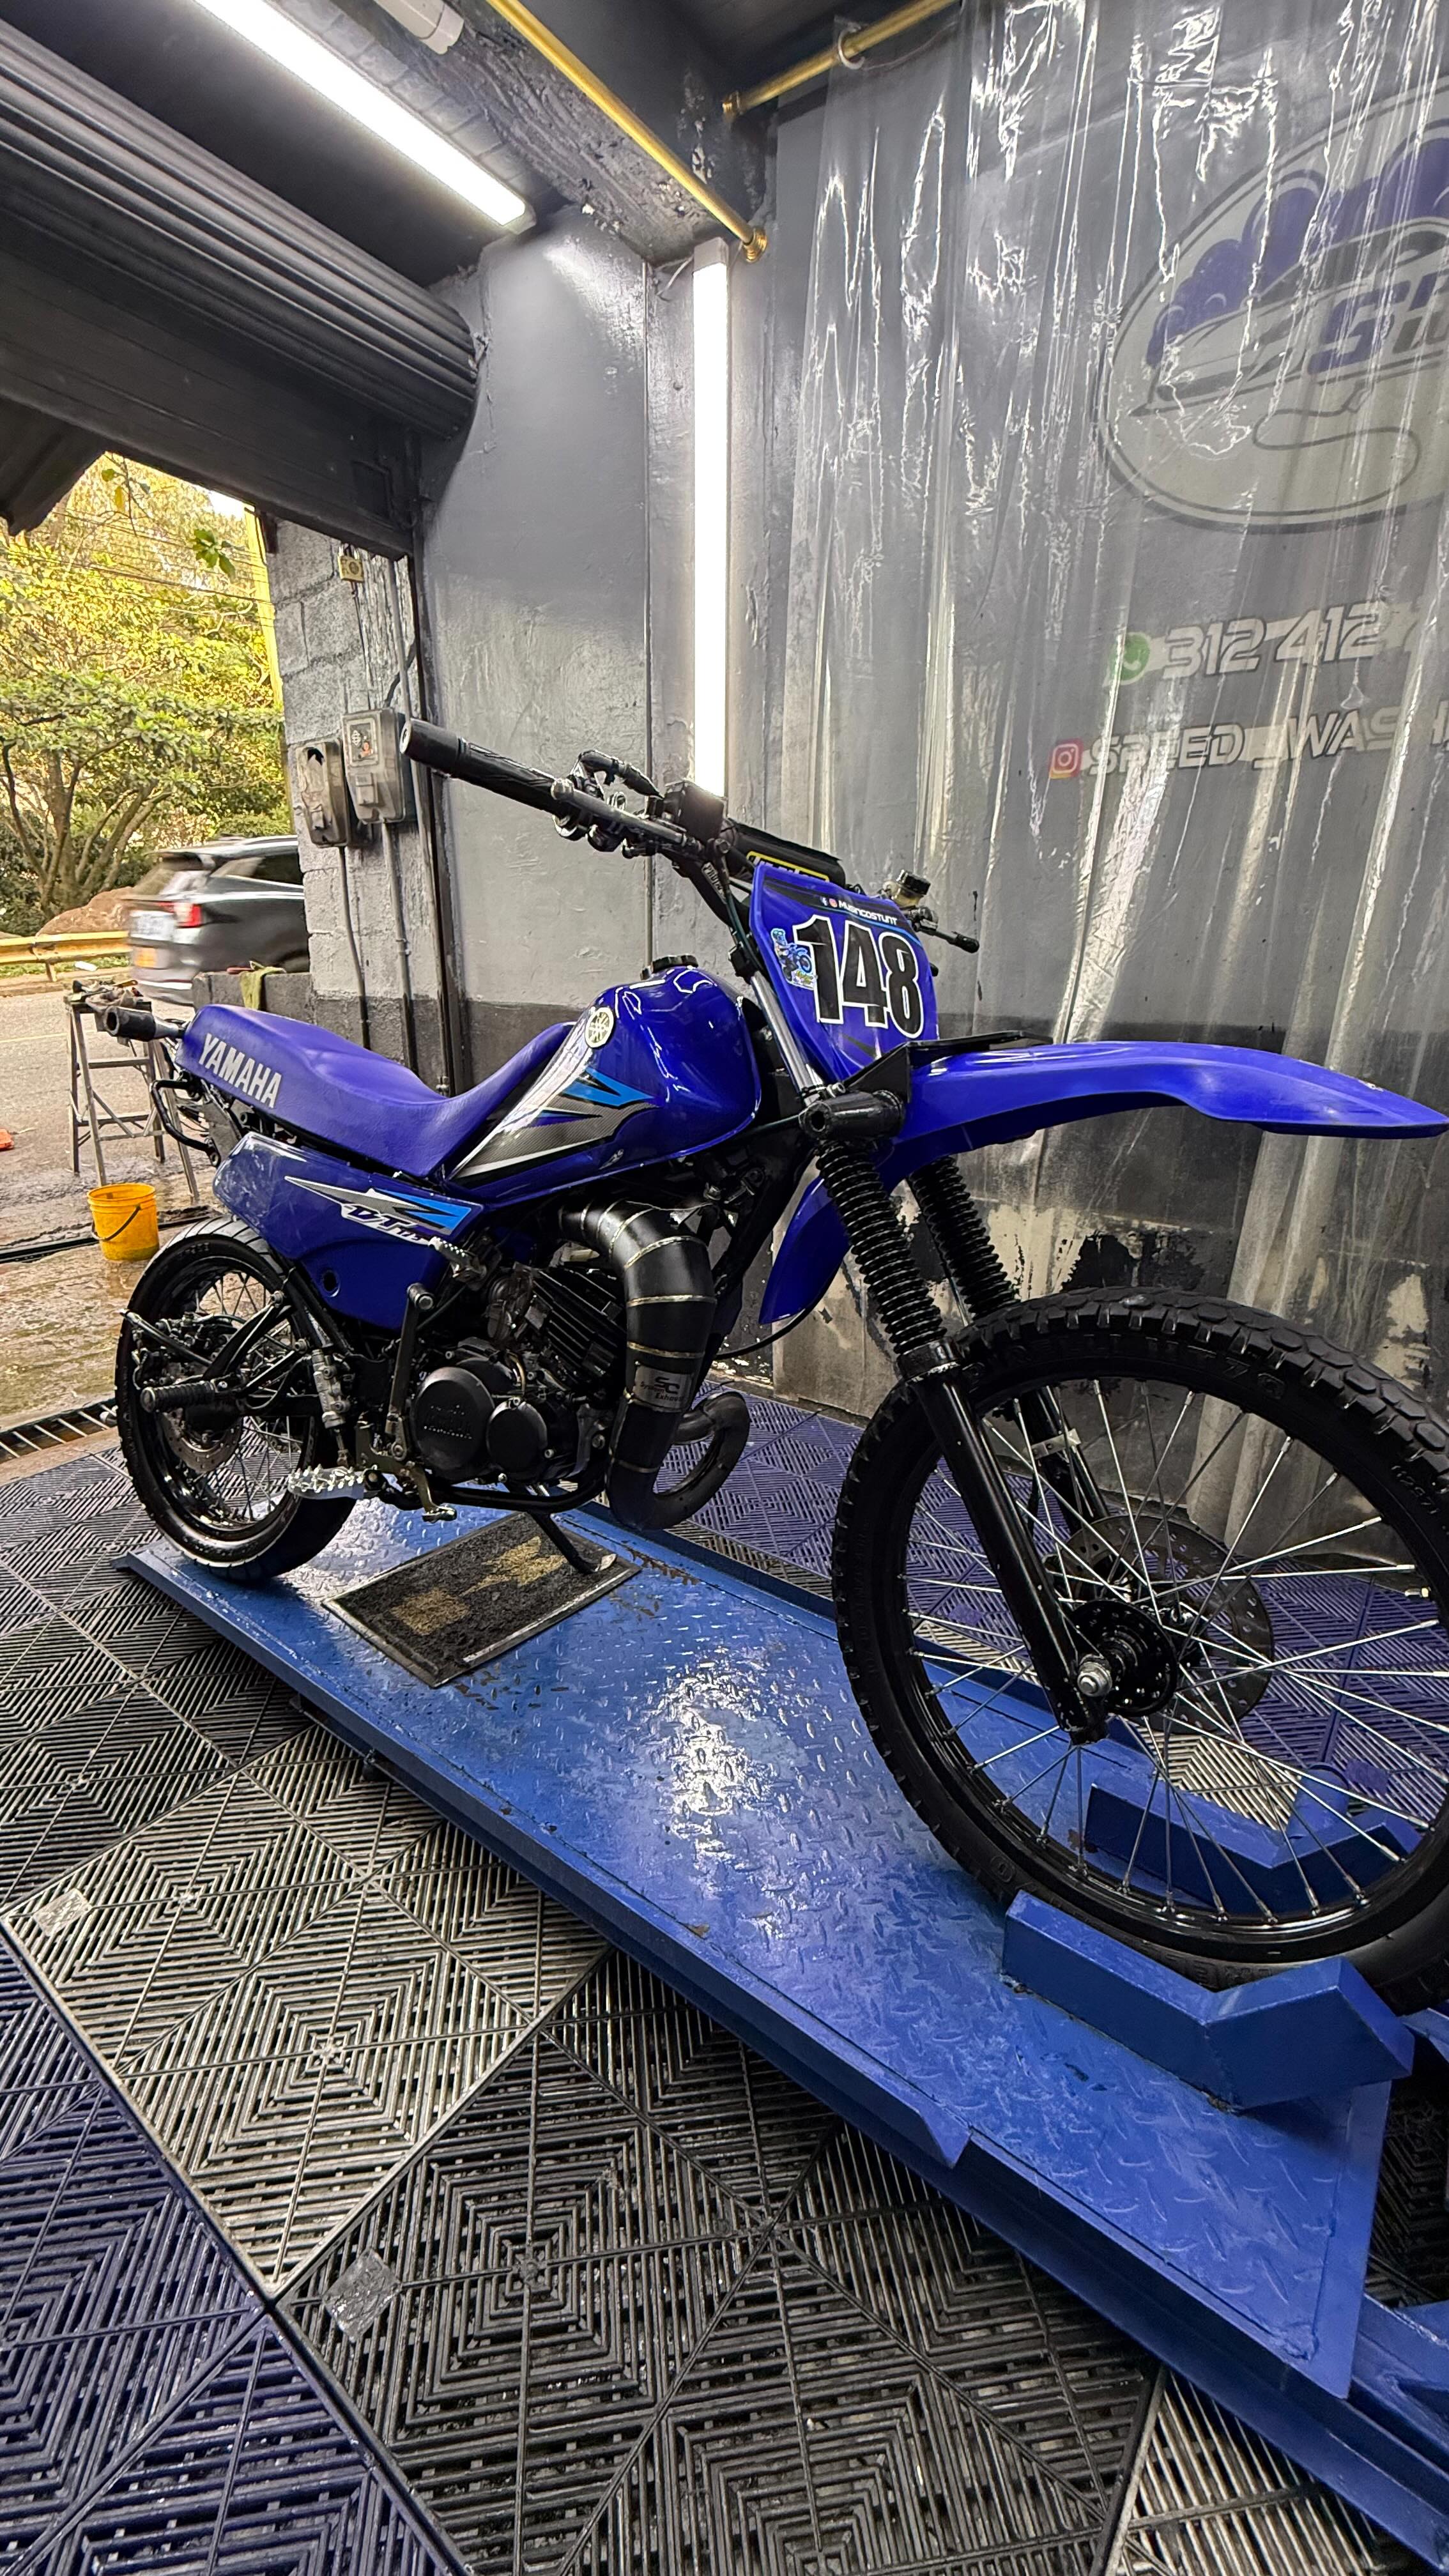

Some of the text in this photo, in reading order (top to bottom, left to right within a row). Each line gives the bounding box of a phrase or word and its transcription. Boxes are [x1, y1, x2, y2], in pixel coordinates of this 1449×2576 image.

[1162, 617, 1266, 680] 312
[792, 914, 924, 1039] 148
[199, 1032, 282, 1108] YAMAHA
